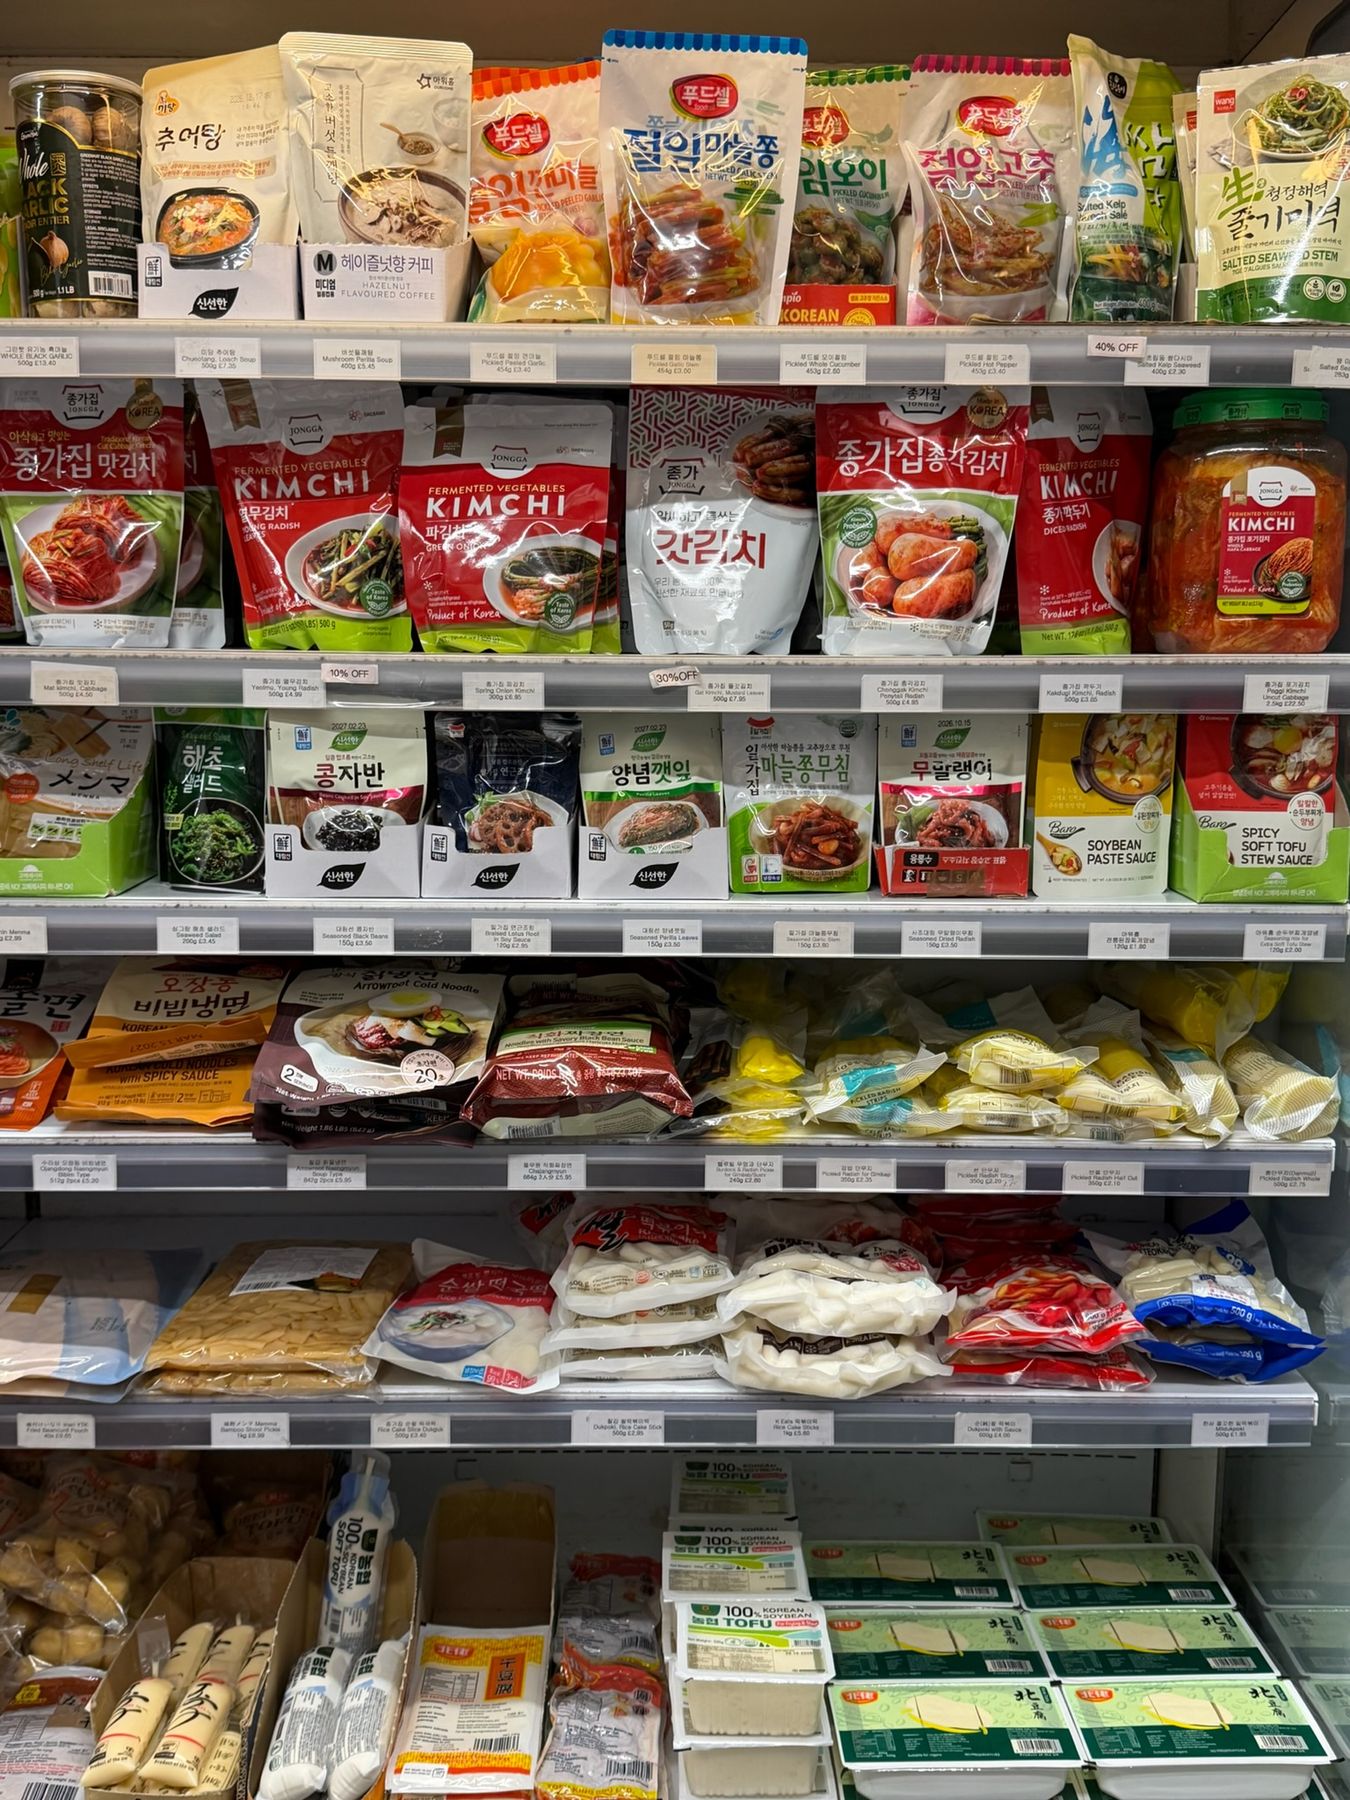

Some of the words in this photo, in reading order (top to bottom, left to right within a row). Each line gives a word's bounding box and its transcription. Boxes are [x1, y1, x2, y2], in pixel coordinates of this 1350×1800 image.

[682, 86, 730, 108] 푸드셀
[1216, 97, 1236, 107] wang
[155, 125, 225, 152] 추어탕
[705, 132, 779, 168] 마늘쫑
[1266, 180, 1328, 203] 청정해역
[1106, 200, 1126, 210] Kelp
[318, 253, 334, 272] M
[340, 254, 406, 274] 헤이즐넛향
[408, 256, 434, 275] 커피
[1222, 254, 1256, 272] SALTED
[1312, 250, 1338, 262] STEM
[362, 282, 411, 290] HAZELNUT
[341, 290, 396, 299] FLAVOURED
[399, 291, 435, 300] COFFEE
[197, 297, 228, 311] 신선한
[781, 309, 839, 322] KOREAN
[1094, 343, 1115, 352] 40%
[1118, 343, 1138, 352] OFF
[66, 392, 99, 406] 종가집
[908, 387, 941, 401] 종가집
[290, 426, 323, 436] JONGGA
[11, 443, 92, 482] 종가집
[98, 452, 157, 479] 맛김치
[492, 454, 528, 464] JONGGA
[835, 436, 924, 476] 종가집
[926, 448, 1008, 478] 총각김치
[234, 464, 298, 476] FERMENTED
[300, 458, 368, 471] VEGETABLES
[666, 466, 698, 482] 종가
[1039, 461, 1076, 475] FERMENTED
[234, 469, 370, 500] KIMCHI
[429, 485, 494, 496] FERMENTED
[497, 484, 566, 493] VEGETABLES
[1040, 471, 1117, 501] KIMCHI
[426, 494, 565, 518] KIMCHI
[1228, 517, 1294, 532] KIMCHI
[655, 528, 766, 570] 갓김치
[1039, 608, 1078, 621] Product
[330, 670, 348, 678] 10%
[351, 669, 369, 678] OFF
[656, 670, 698, 684] 30%OFF
[937, 719, 972, 728] 2026.10.15
[182, 744, 223, 773] 해초
[314, 762, 385, 788] 콩자반
[612, 759, 690, 787] 양념깻잎
[746, 744, 761, 796] 일가집
[762, 753, 850, 784] 마늘쫑무침
[49, 771, 130, 795] メンマ
[1049, 820, 1077, 837] Baro
[1242, 828, 1280, 839] SPICY
[1088, 839, 1142, 852] SOYBEAN
[1242, 842, 1274, 852] SOFT
[1277, 842, 1306, 852] TOFU
[1088, 854, 1124, 866] PASTE
[1126, 852, 1156, 865] SAUCE
[1241, 855, 1275, 866] STEW
[1278, 855, 1312, 866] SAUCE
[325, 870, 355, 883] 신선한
[480, 870, 508, 884] 신선한
[638, 870, 666, 883] 신선한
[339, 939, 354, 947] 150g
[156, 976, 239, 994] 오장동
[354, 980, 408, 992] Arrowroot
[413, 980, 438, 990] Cold
[133, 991, 250, 1019] 비빔냉면
[504, 1038, 533, 1048] Noodles
[553, 1037, 578, 1047] Savory
[622, 1036, 645, 1044] Sauce
[120, 1075, 140, 1084] WITH
[144, 1071, 178, 1083] SPICY
[181, 1070, 219, 1082] SAUCE
[284, 1068, 295, 1083] 2
[496, 1069, 512, 1080] NET
[878, 1088, 901, 1096] RADISH
[866, 1096, 888, 1105] STRIPS
[1230, 1304, 1244, 1317] 500
[712, 1462, 742, 1472] 100%
[711, 1472, 750, 1480] TOFU
[336, 1520, 348, 1552] SOFT
[706, 1536, 739, 1546] 100%
[706, 1546, 749, 1554] TOFU
[330, 1555, 340, 1587] TOFU
[346, 1552, 358, 1590] KOREAN
[725, 1605, 762, 1618] 100%
[722, 1618, 772, 1629] TOFU
